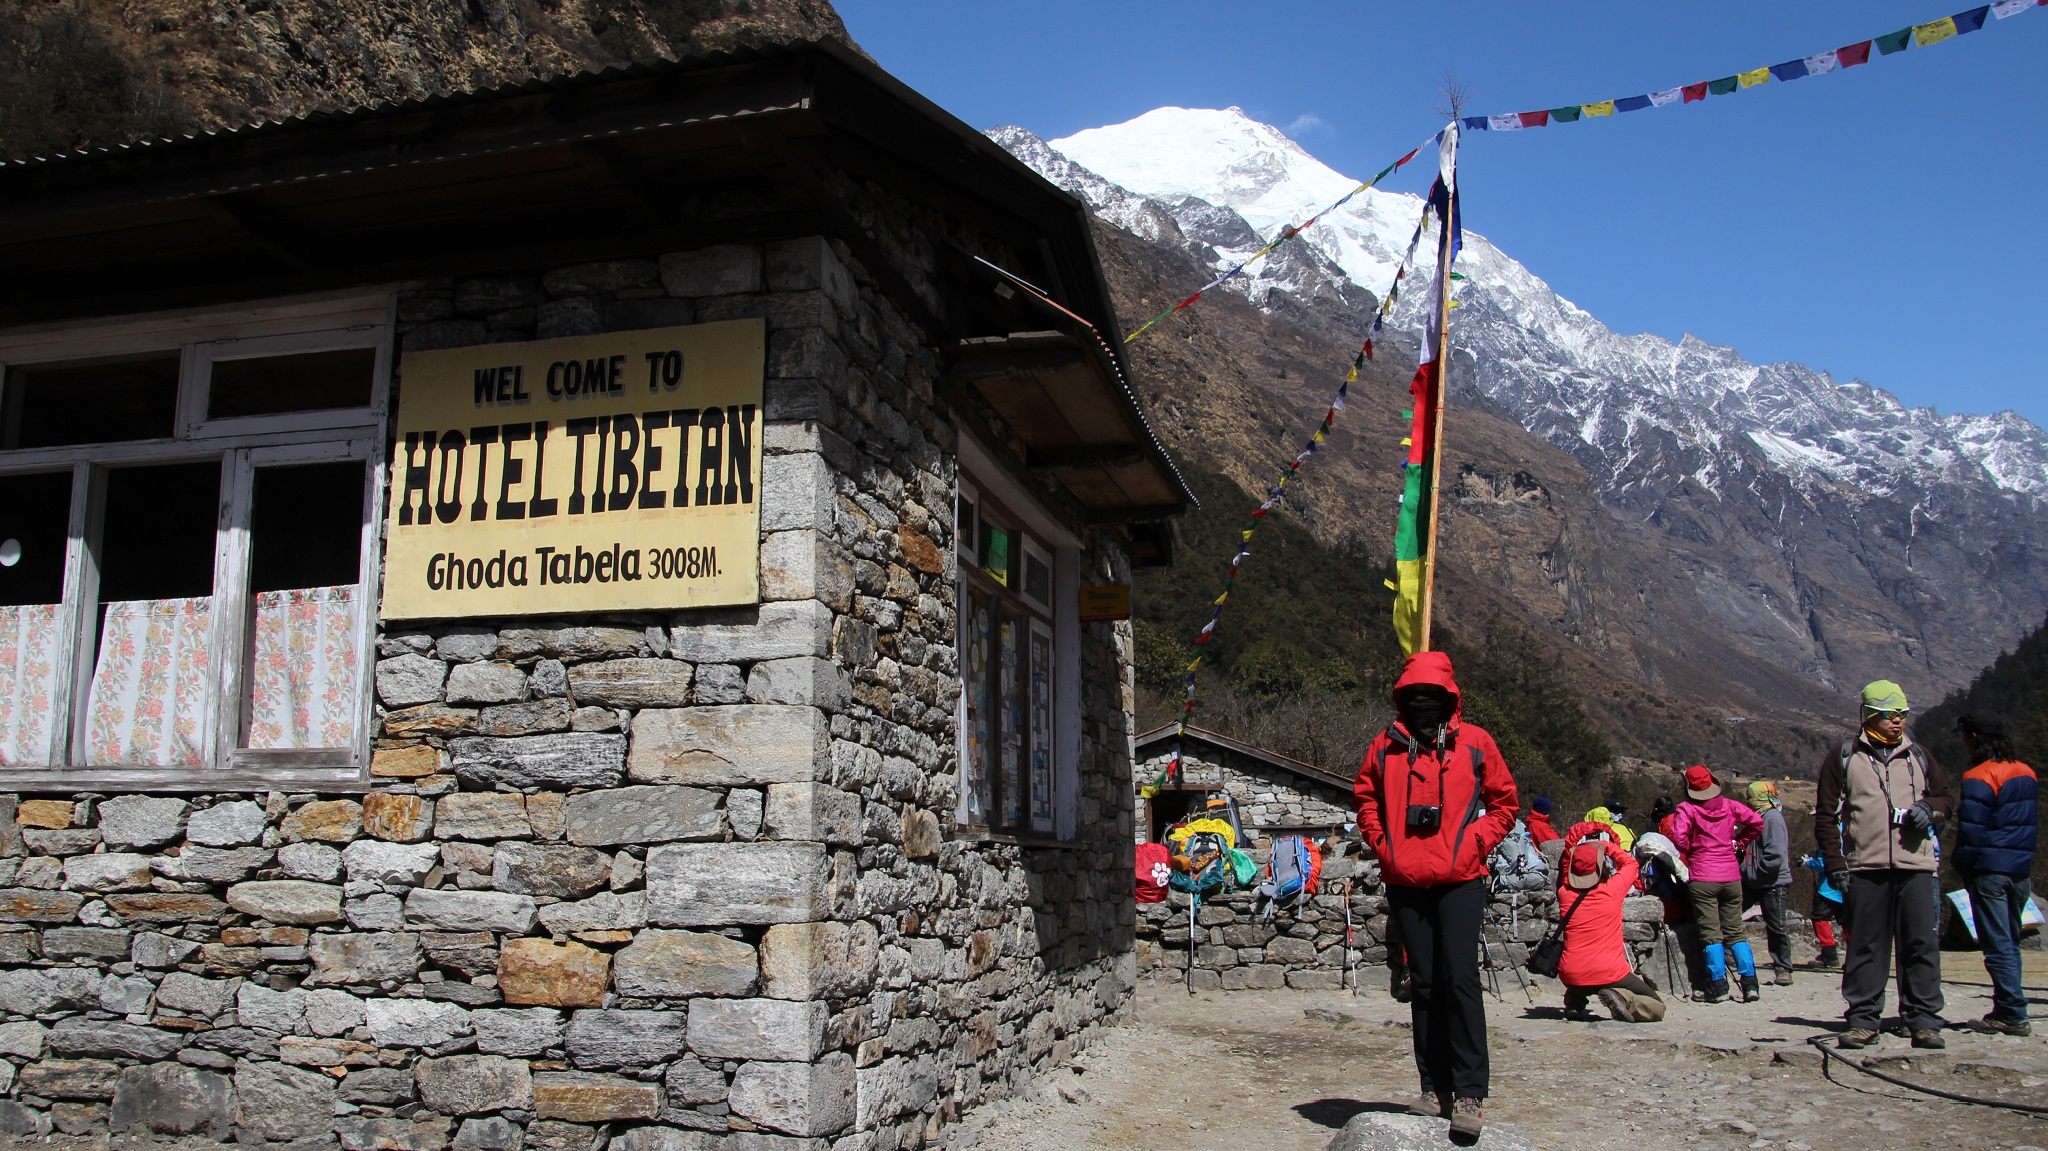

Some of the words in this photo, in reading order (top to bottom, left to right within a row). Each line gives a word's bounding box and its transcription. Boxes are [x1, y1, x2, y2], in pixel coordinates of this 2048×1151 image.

[474, 365, 530, 407] WEL
[546, 355, 627, 398] COME
[645, 349, 684, 389] TO
[398, 420, 558, 526] HOTEL
[566, 403, 756, 515] TIBETAN
[426, 549, 528, 591] Ghoda
[535, 542, 642, 586] Tabela
[647, 546, 723, 580] 3008M.
